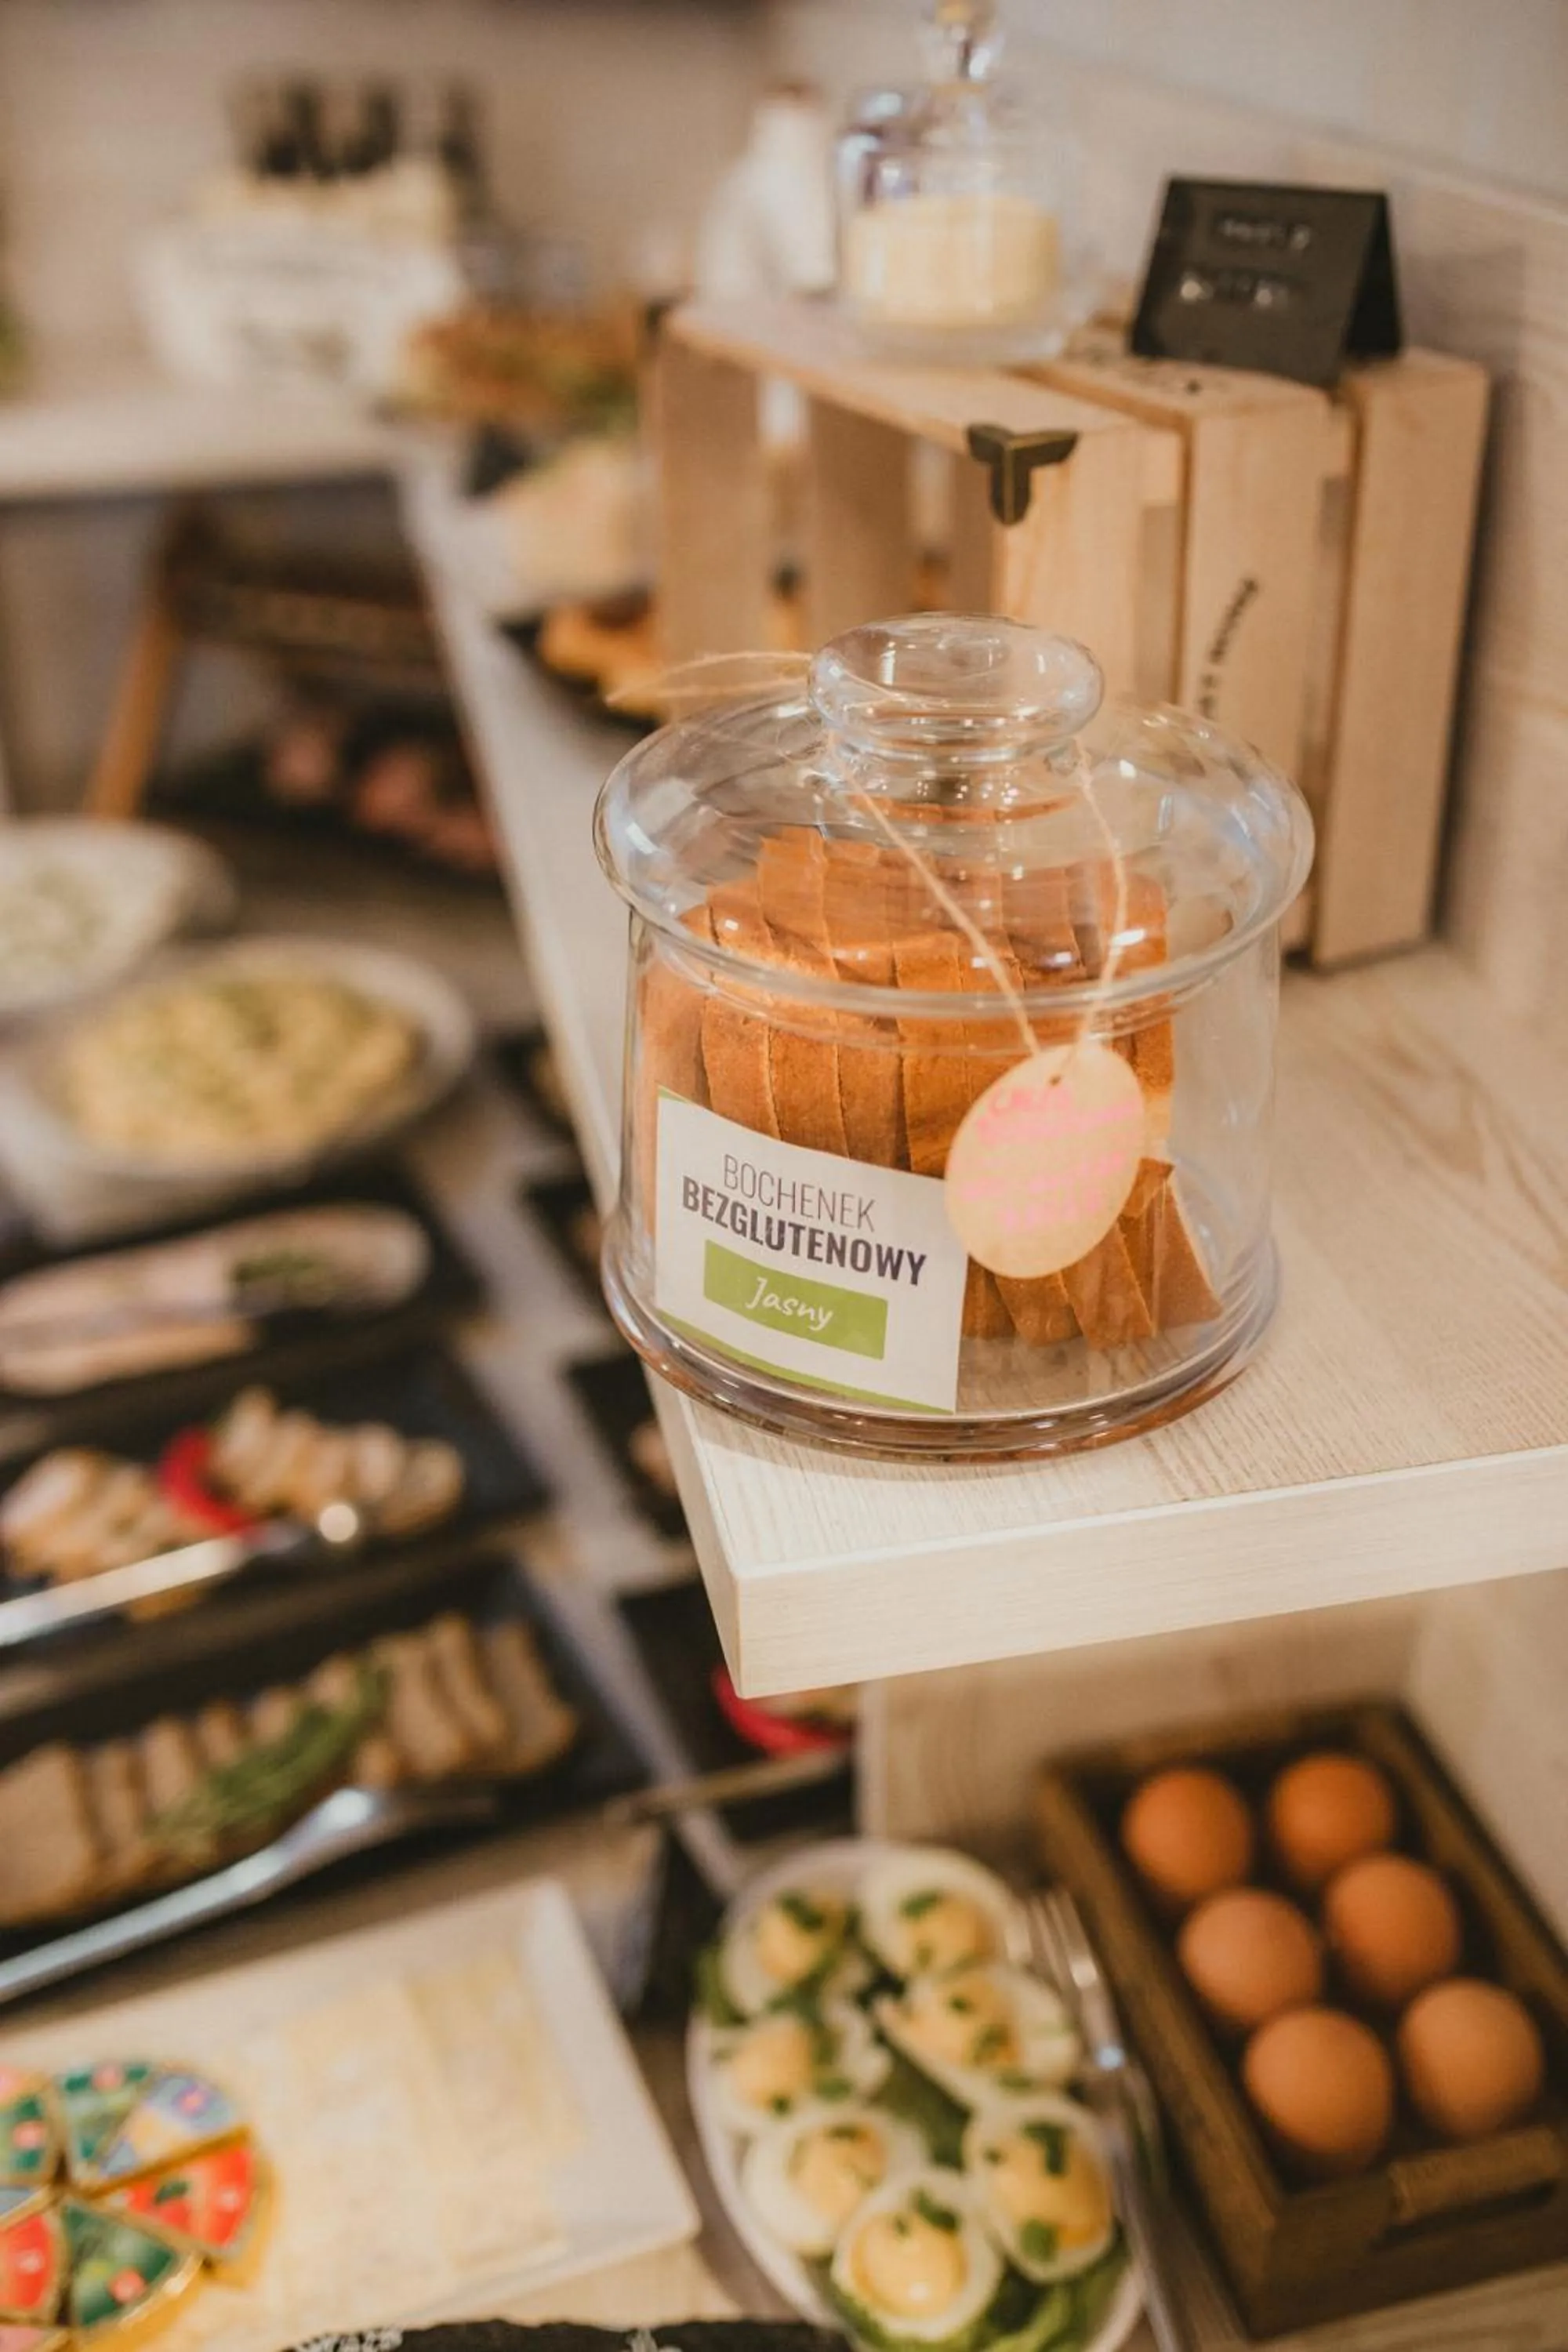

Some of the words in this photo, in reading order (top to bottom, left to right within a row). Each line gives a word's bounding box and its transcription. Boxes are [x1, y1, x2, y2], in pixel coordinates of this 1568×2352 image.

[682, 1176, 927, 1286] BEZGLUTENOWY
[724, 1154, 876, 1232] BOCHENEK
[746, 1277, 833, 1331] Jasny
